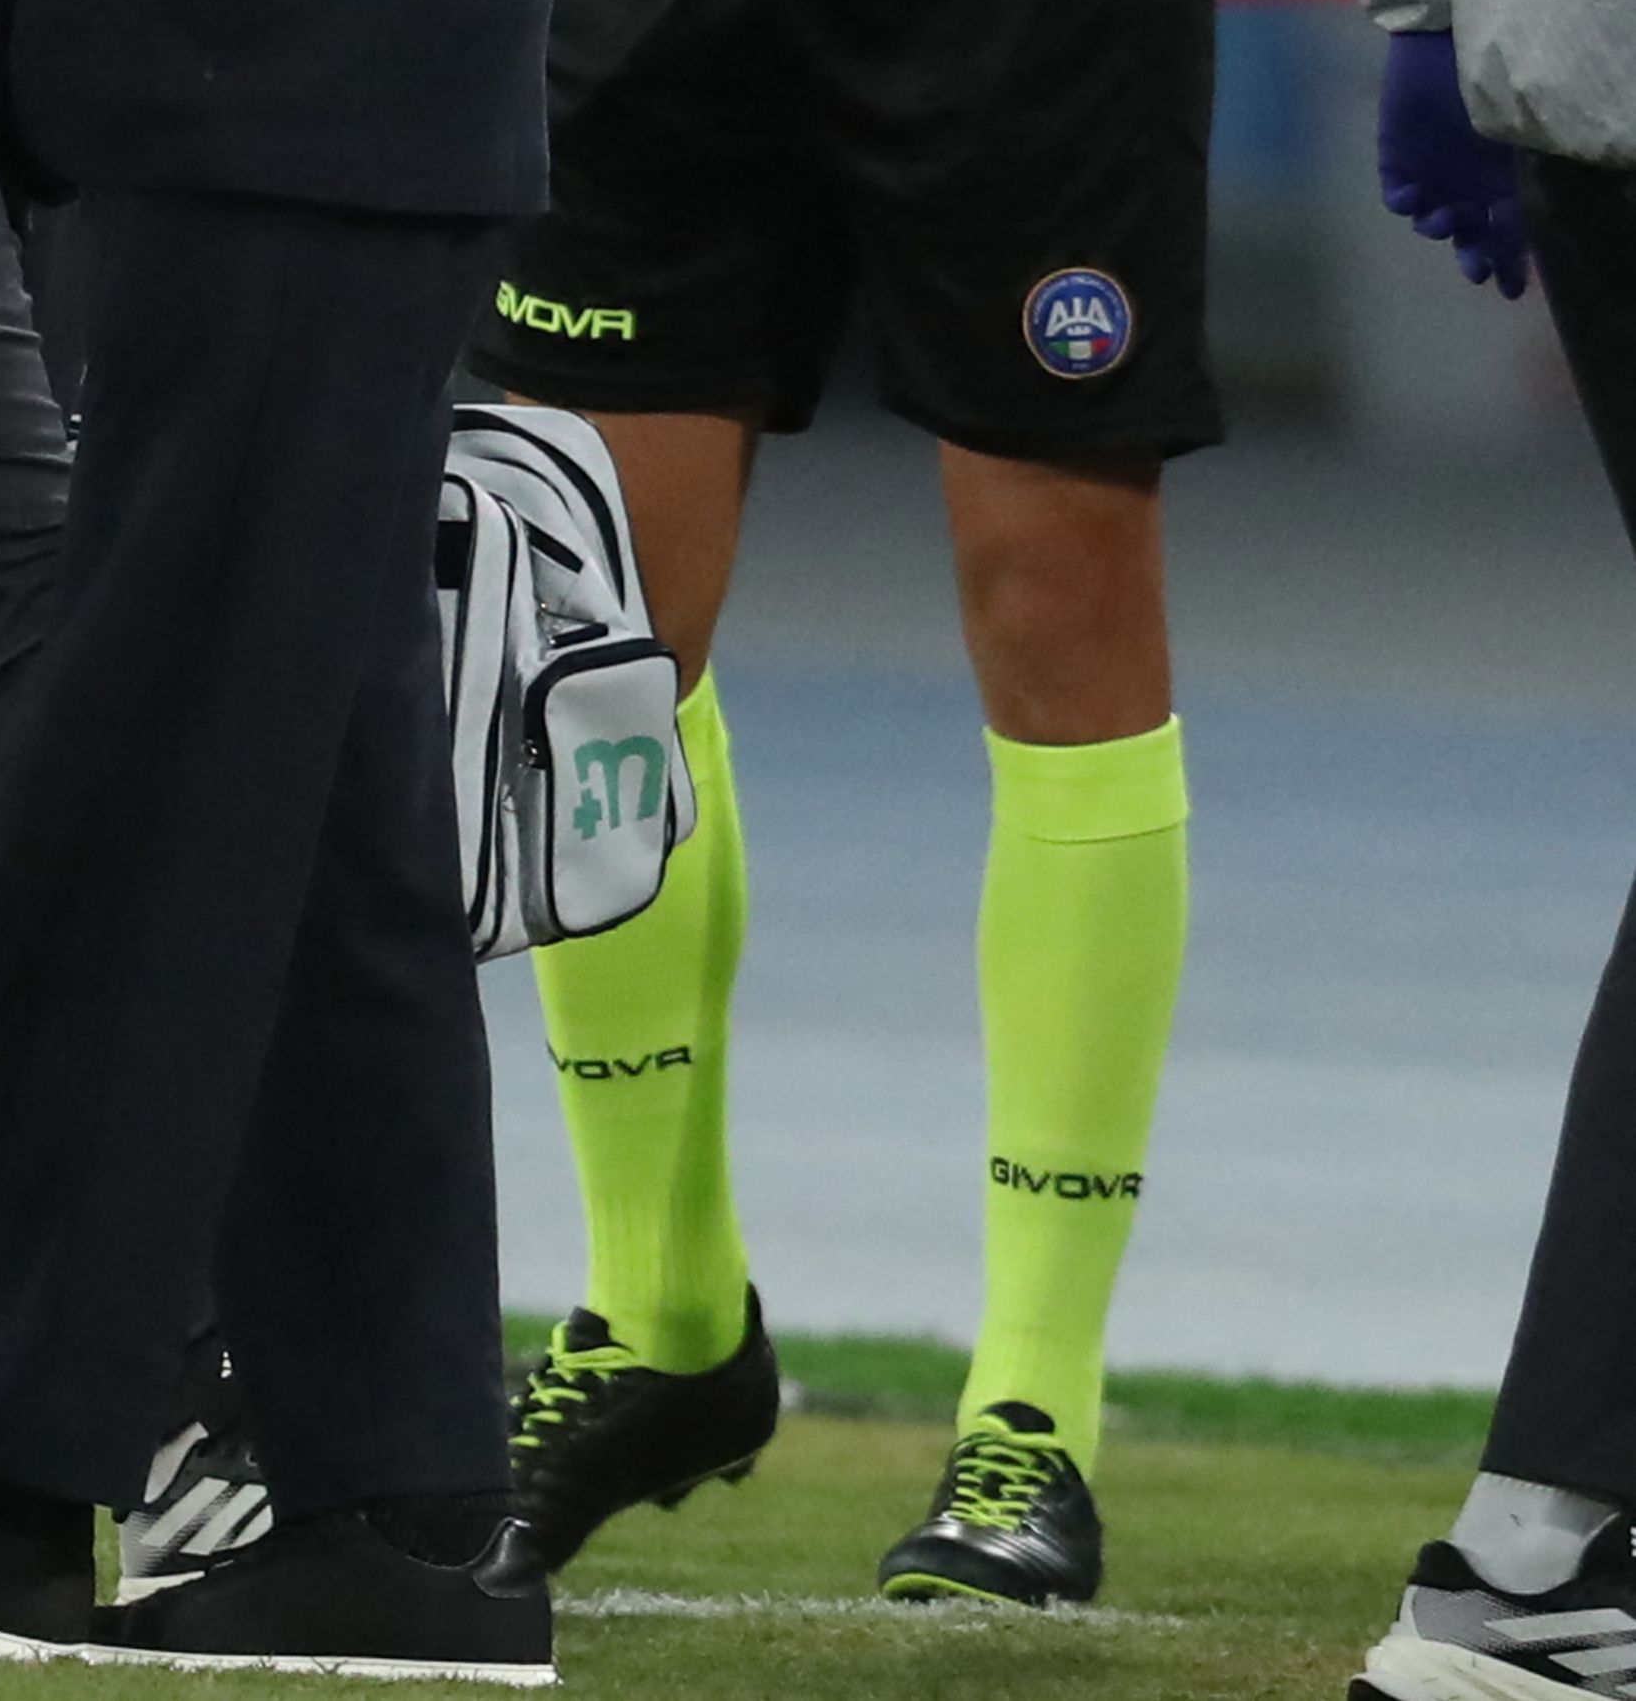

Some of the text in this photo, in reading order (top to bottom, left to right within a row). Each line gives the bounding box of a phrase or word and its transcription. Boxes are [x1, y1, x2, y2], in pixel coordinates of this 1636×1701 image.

[1044, 296, 1113, 337] AIA
[546, 1040, 693, 1080] VOVA
[990, 1155, 1143, 1200] GIVOVA
